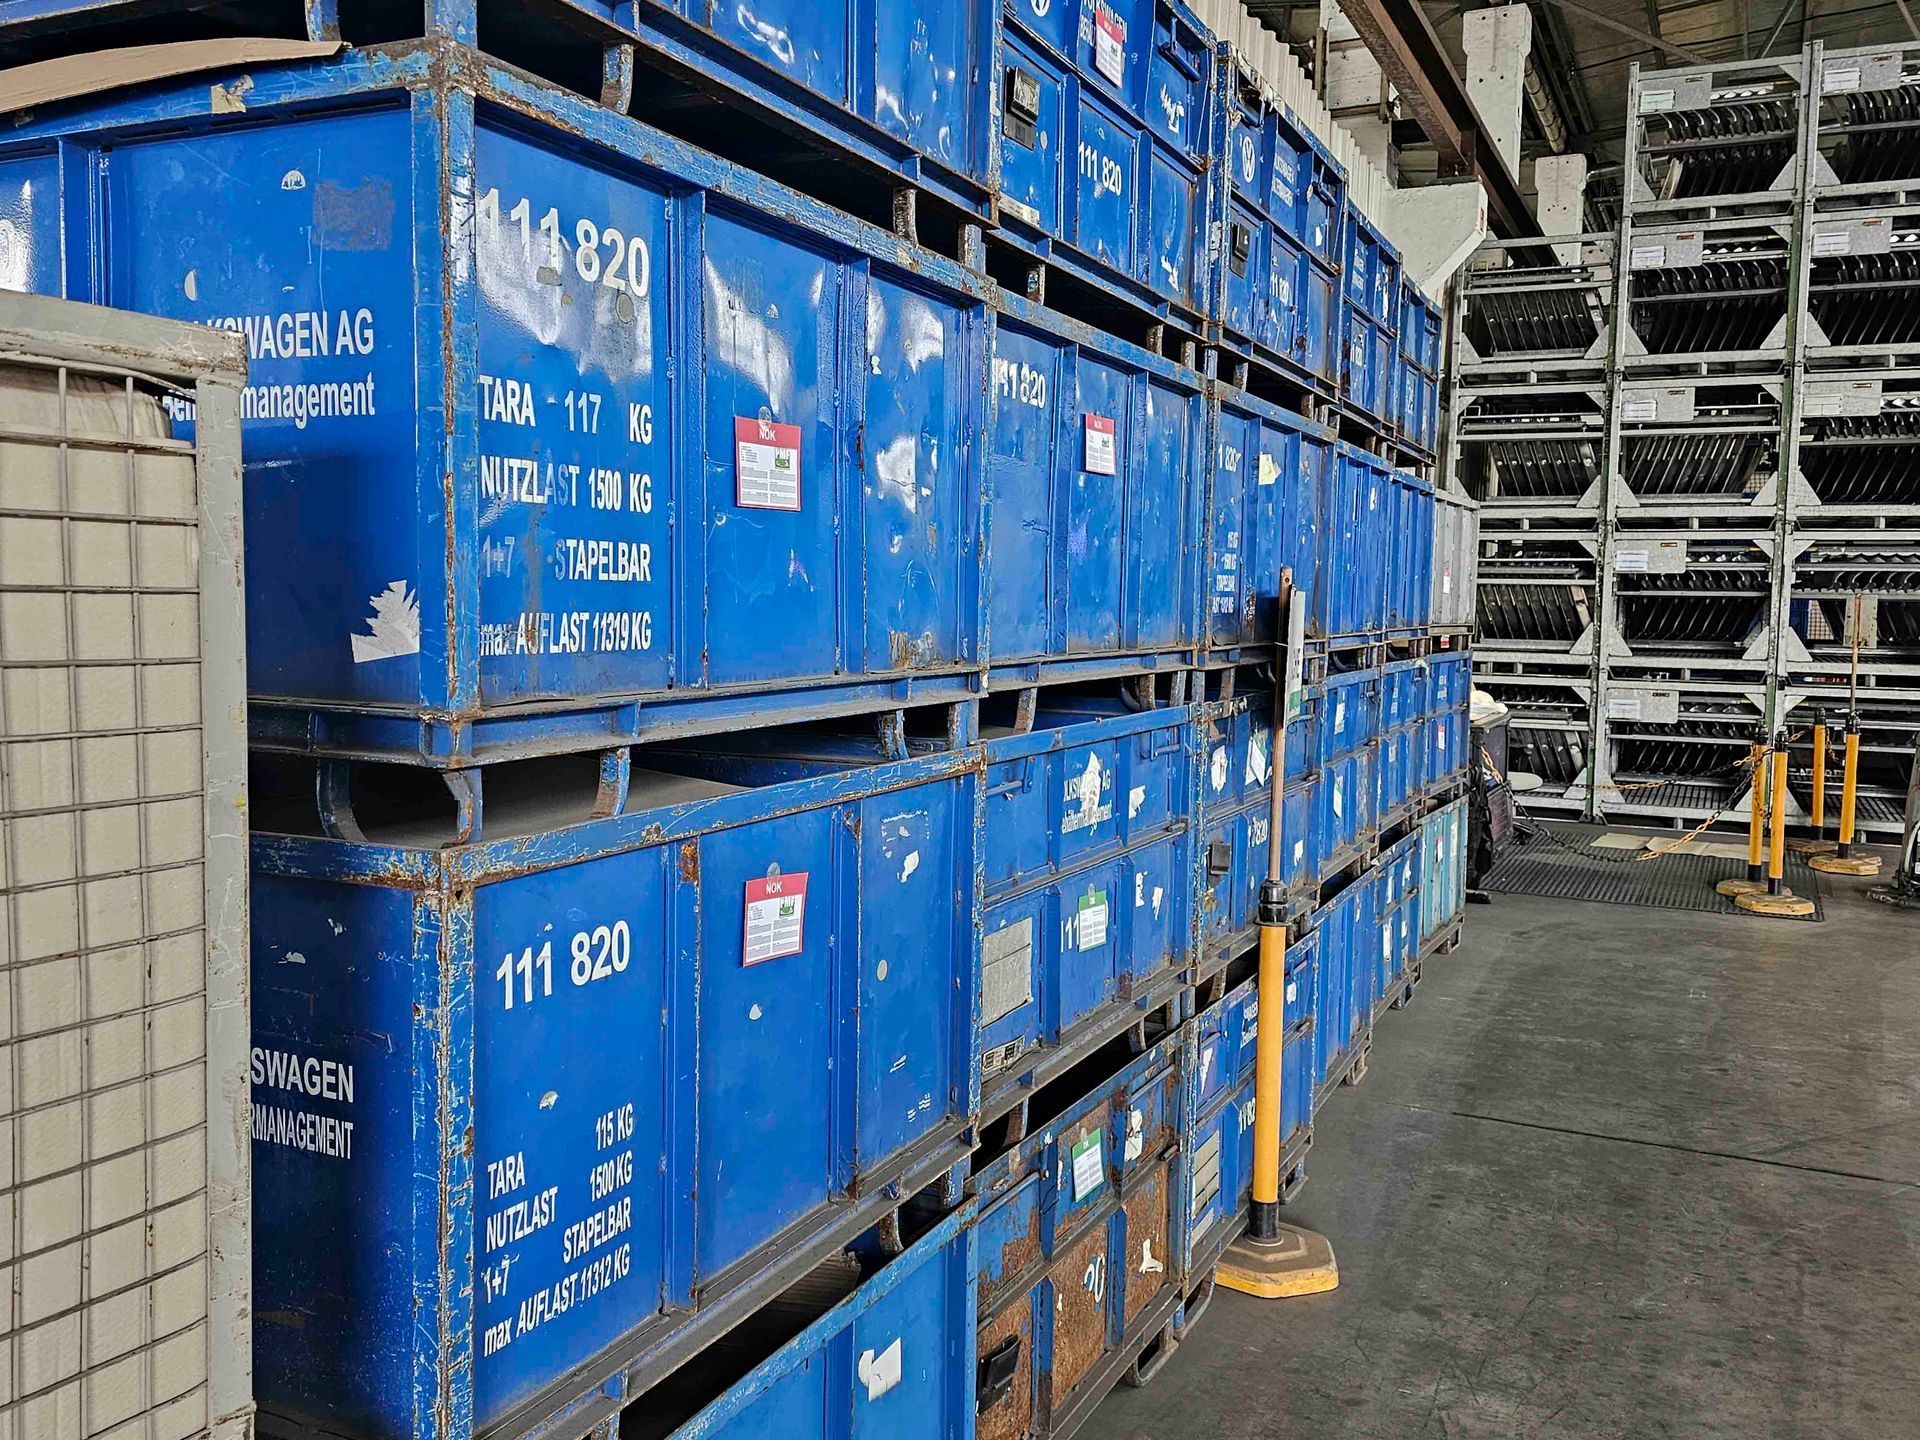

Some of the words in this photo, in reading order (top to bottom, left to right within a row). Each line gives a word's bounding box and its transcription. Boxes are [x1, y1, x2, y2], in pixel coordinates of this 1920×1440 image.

[1079, 141, 1097, 181] 111
[1102, 156, 1122, 196] 820
[480, 188, 559, 268] 111
[576, 218, 649, 297] 820
[335, 308, 374, 355] AG
[479, 375, 536, 427] TARA
[564, 391, 602, 433] 117
[629, 403, 652, 445] KG
[1020, 362, 1045, 409] 820
[759, 426, 776, 441] NOK
[480, 455, 580, 507] NUTZLAST
[588, 468, 622, 511] 1500
[629, 472, 652, 513] KG
[482, 536, 514, 578] 1+7
[554, 538, 651, 582] STAPELBAR
[516, 612, 590, 656] AUFLAST
[593, 611, 629, 652] 11319
[631, 611, 652, 650] KG
[766, 881, 782, 895] NOK
[496, 941, 552, 1010] 111
[571, 920, 630, 986] 820
[250, 1047, 354, 1103] SWAGEN
[487, 1151, 526, 1200] TARA
[595, 1110, 614, 1151] 115
[617, 1102, 634, 1143] KG
[485, 1186, 559, 1253] NUTZLAST
[590, 1162, 615, 1202] 1500
[615, 1150, 633, 1190] KG
[483, 1260, 510, 1304] 1+7
[563, 1196, 632, 1264] STAPELBAR
[484, 1317, 511, 1357] max
[516, 1275, 579, 1338] AUFLAST
[580, 1254, 612, 1302] 11312
[612, 1243, 630, 1281] KG
